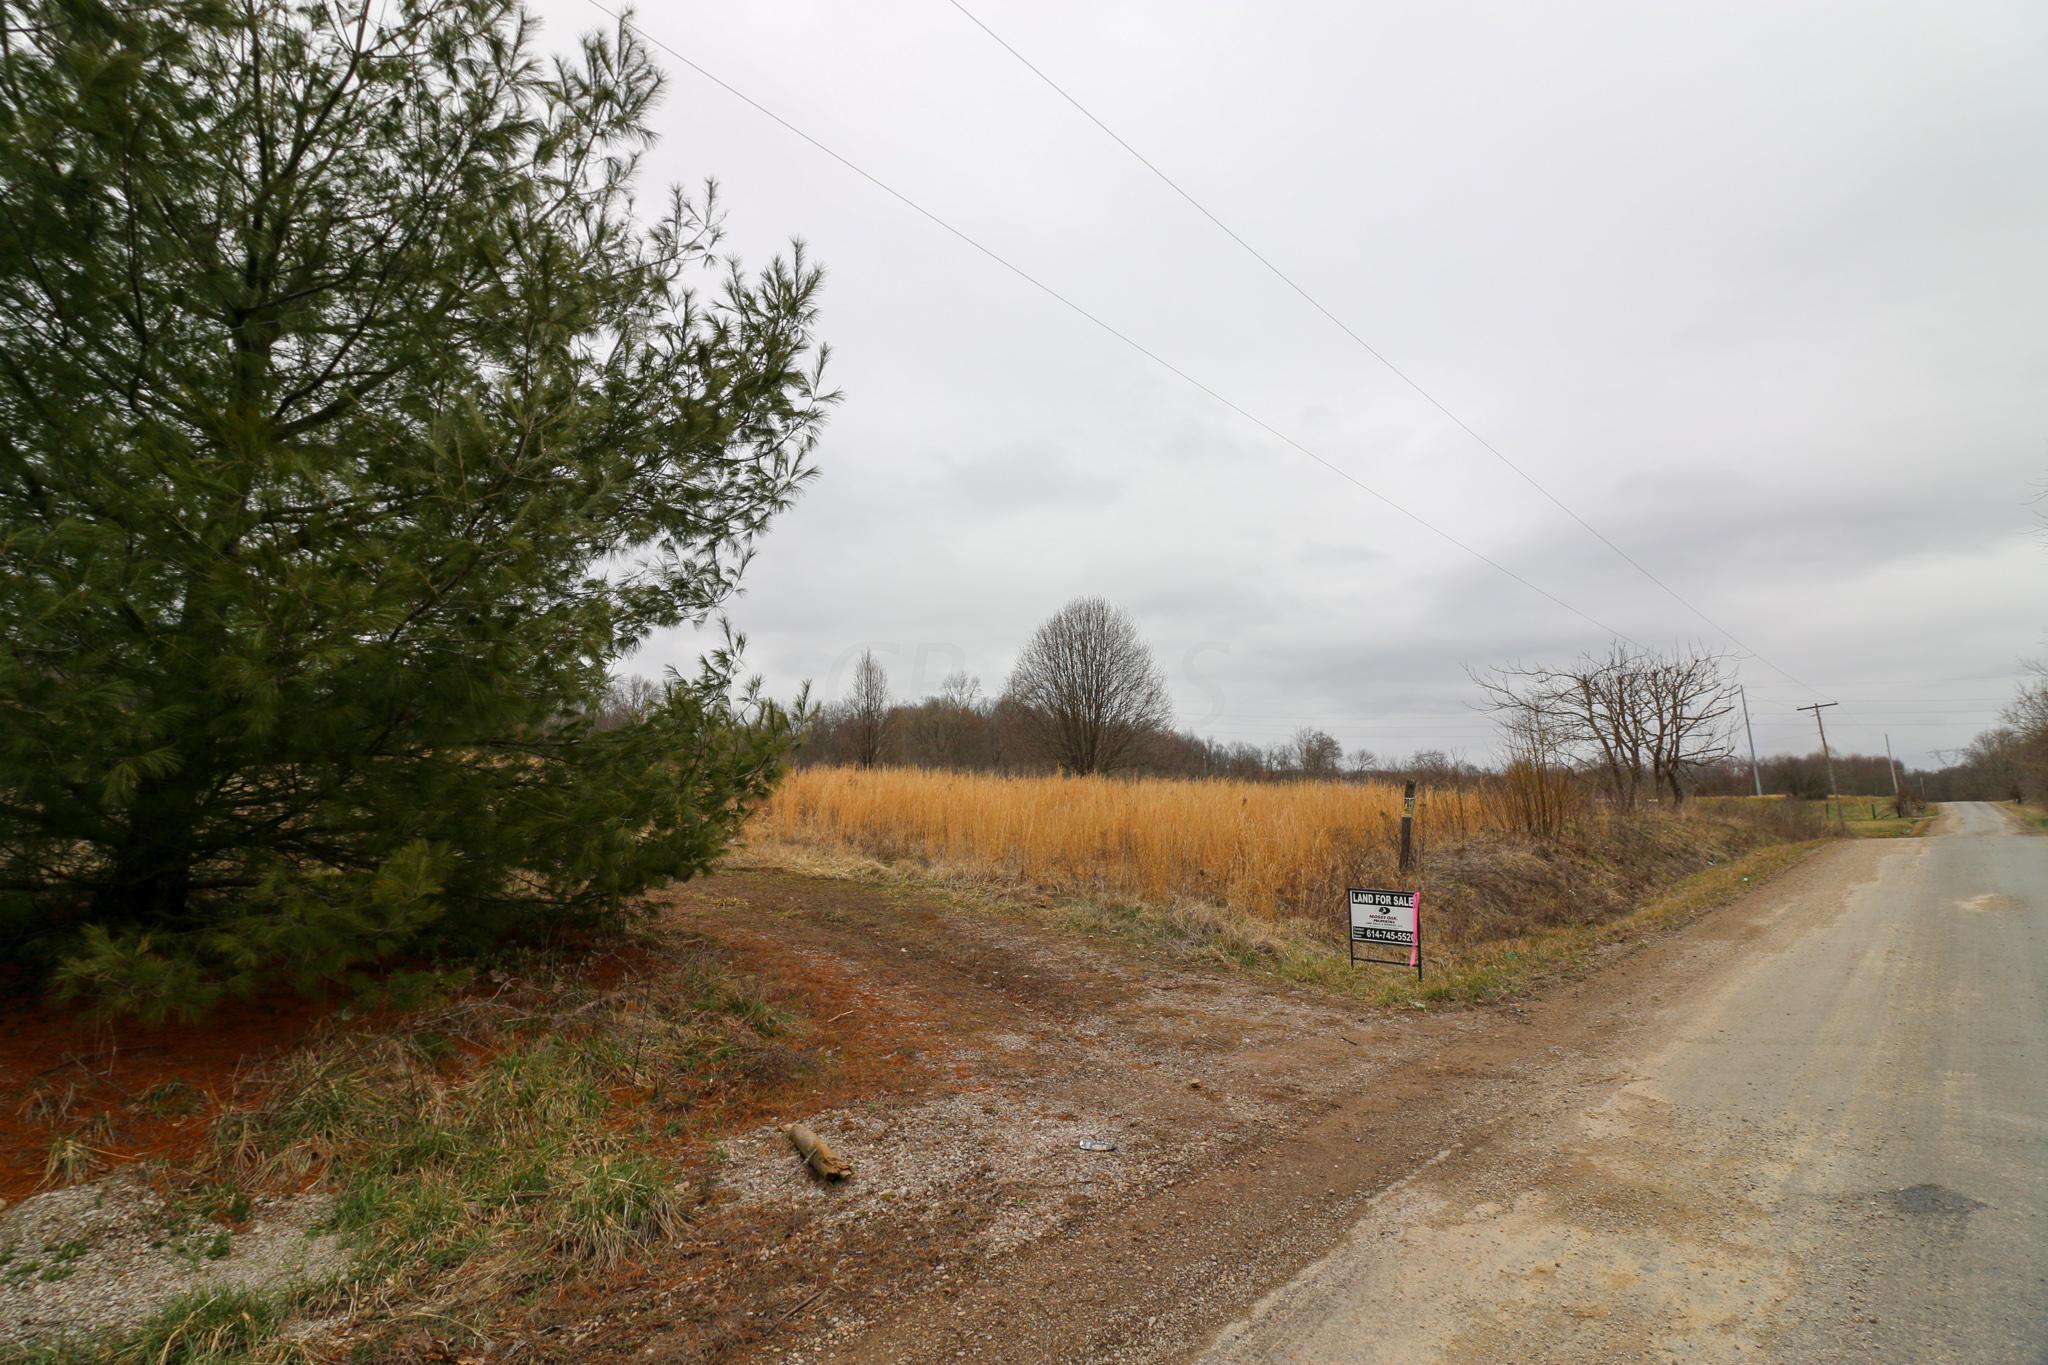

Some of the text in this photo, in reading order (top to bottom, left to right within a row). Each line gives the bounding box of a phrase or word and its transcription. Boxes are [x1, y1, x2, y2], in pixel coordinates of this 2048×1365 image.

[1353, 893, 1413, 906] LAND FOR SALE
